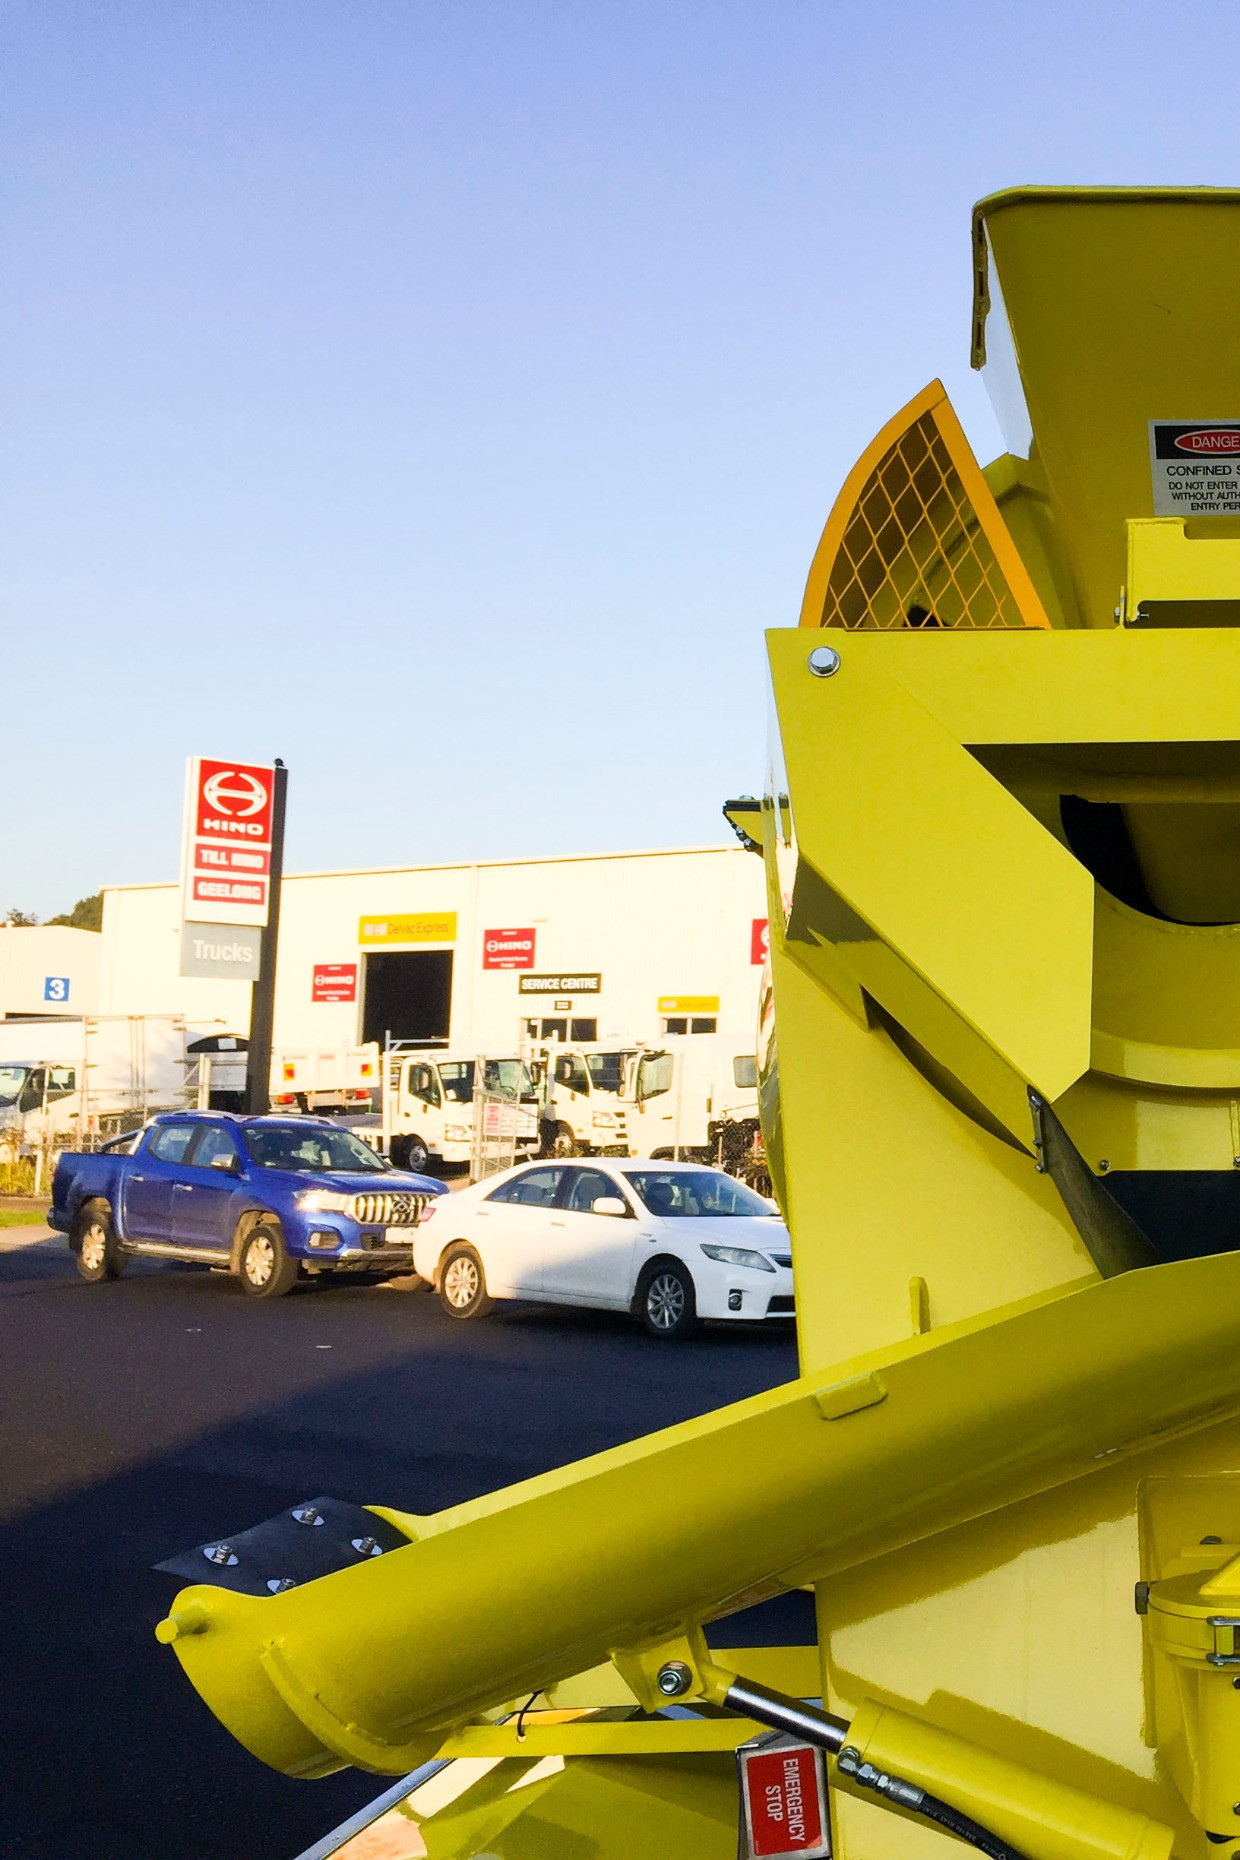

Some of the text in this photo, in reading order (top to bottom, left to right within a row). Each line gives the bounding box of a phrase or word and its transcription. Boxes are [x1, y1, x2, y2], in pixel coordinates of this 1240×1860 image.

[1166, 465, 1232, 477] CONFINED
[1168, 481, 1183, 490] DO
[1185, 481, 1205, 490] NOT
[1207, 481, 1237, 490] ENTER
[1171, 491, 1215, 501] WITHOUT
[1191, 502, 1220, 511] ENTRY
[203, 818, 264, 836] HINO
[200, 850, 229, 866] TILL
[197, 881, 261, 900] GEELONG
[416, 922, 449, 936] Express
[193, 939, 253, 962] Trucks
[498, 940, 532, 951] HINO
[325, 975, 355, 985] HINO
[521, 977, 598, 990] SERVICE CENTRE
[48, 978, 65, 1000] 3
[765, 1785, 784, 1822] STOP
[783, 1758, 805, 1841] EMERGENCY
